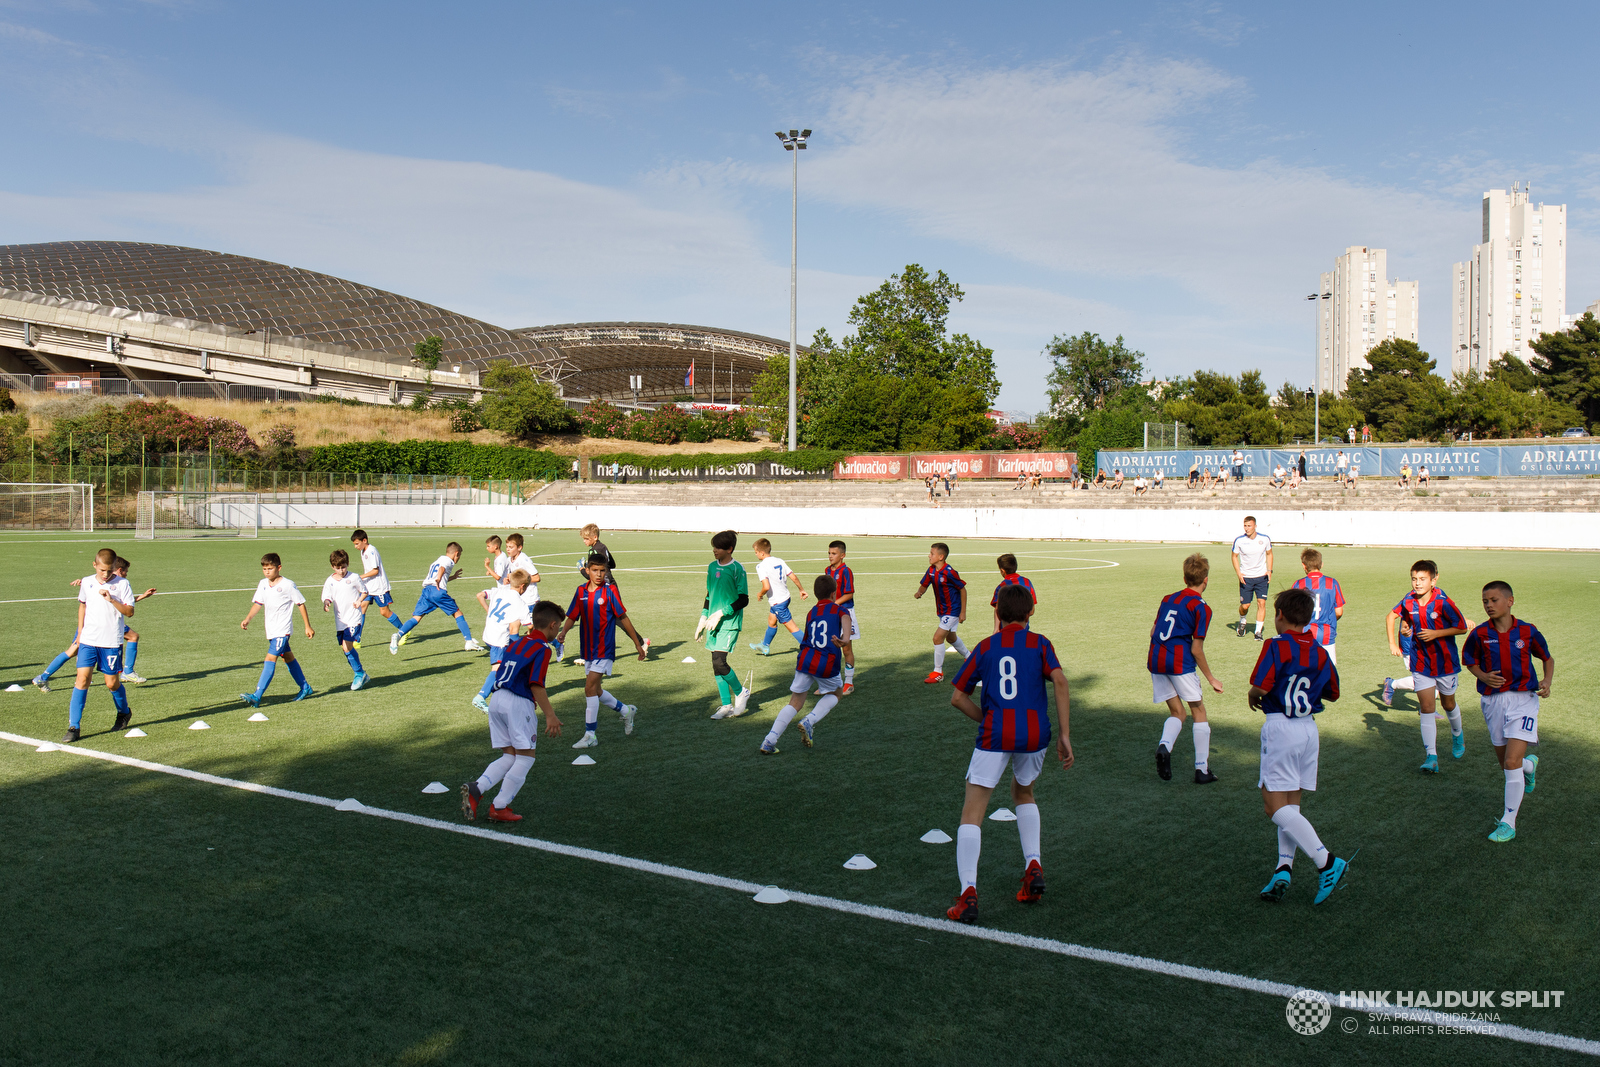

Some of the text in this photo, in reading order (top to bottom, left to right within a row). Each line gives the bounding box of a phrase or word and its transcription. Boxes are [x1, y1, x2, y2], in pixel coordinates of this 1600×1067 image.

[1112, 455, 1177, 467] ADRIATIC
[1400, 452, 1480, 464] ADRIATIC
[1521, 450, 1600, 463] ADRIATI
[997, 458, 1053, 472] Karlovačko
[773, 564, 783, 580] 7
[489, 597, 511, 623] 14
[1159, 609, 1178, 641] 5
[810, 619, 828, 649] 13
[107, 654, 118, 667] 17
[998, 655, 1018, 700] 8
[1451, 676, 1456, 689] 2
[1284, 673, 1312, 718] 16
[1521, 715, 1535, 732] 10
